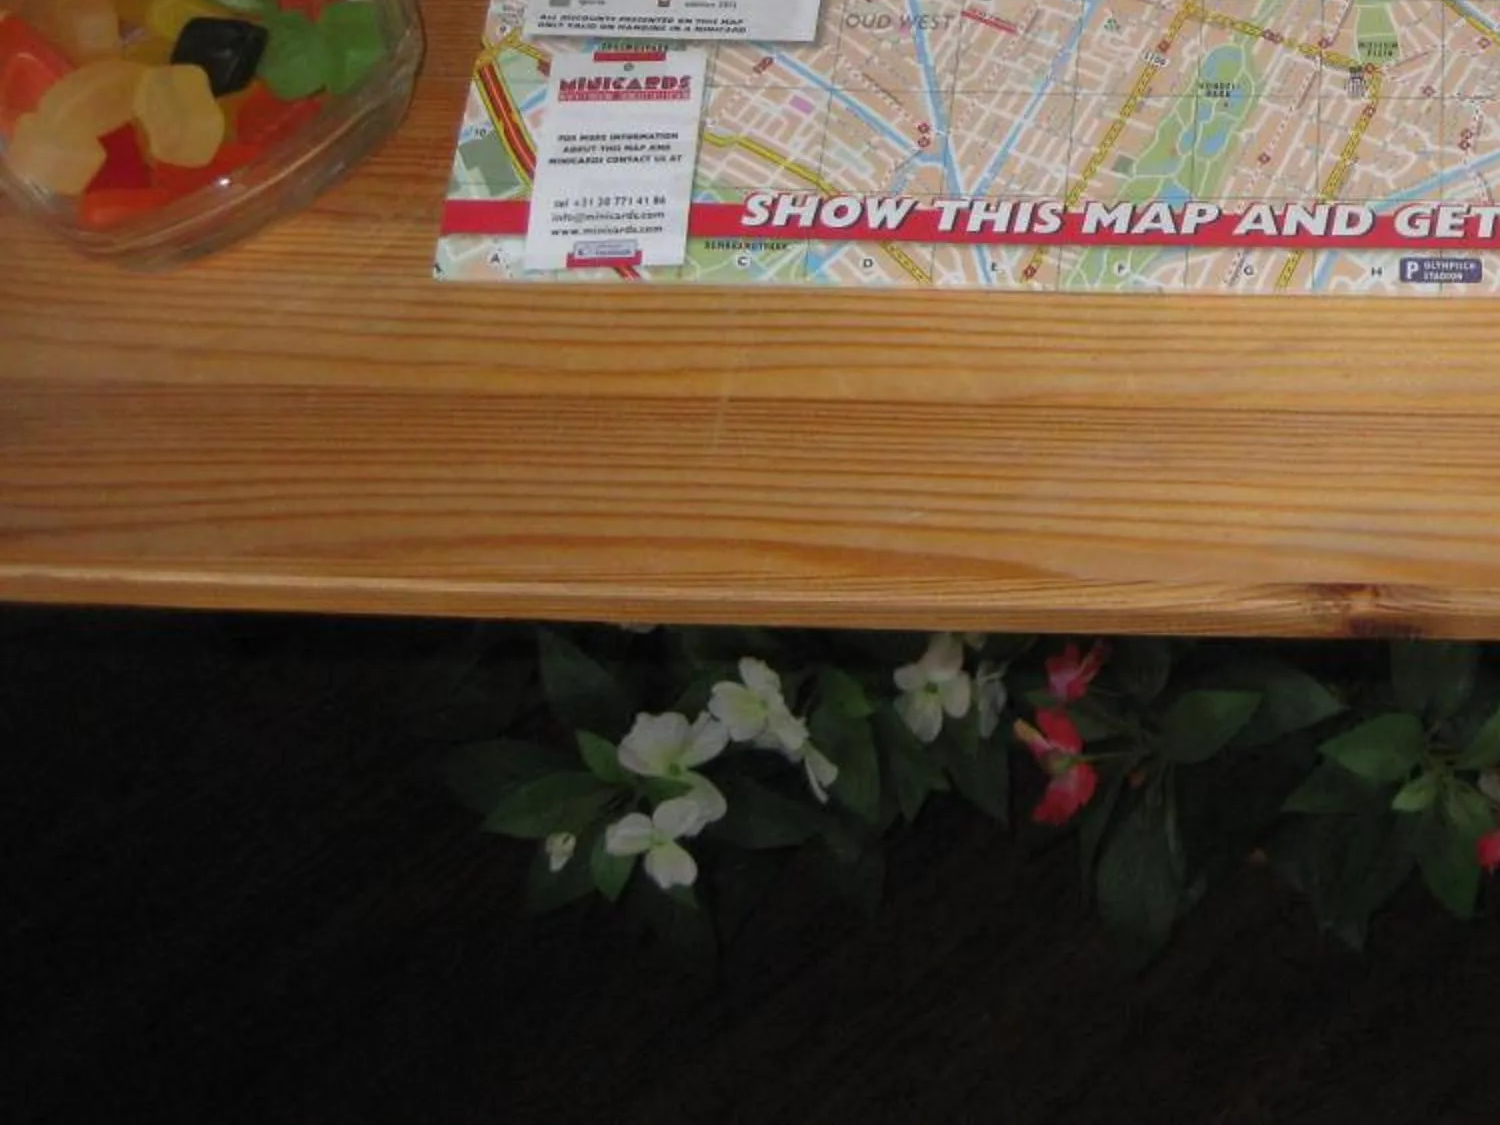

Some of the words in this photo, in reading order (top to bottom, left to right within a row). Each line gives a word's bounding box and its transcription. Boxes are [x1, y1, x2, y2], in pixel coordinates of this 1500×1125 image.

[845, 14, 892, 31] OUD
[901, 14, 955, 31] WEST
[558, 75, 693, 92] MINICARDS
[609, 131, 679, 141] INFORMATION
[624, 143, 646, 153] MAP
[605, 155, 652, 165] CONTACT
[668, 154, 683, 164] AT
[741, 190, 917, 230] SHOW
[934, 197, 1063, 236] THIS
[1080, 200, 1221, 237] MAP
[1230, 201, 1377, 239] AND
[1406, 261, 1419, 280] P
